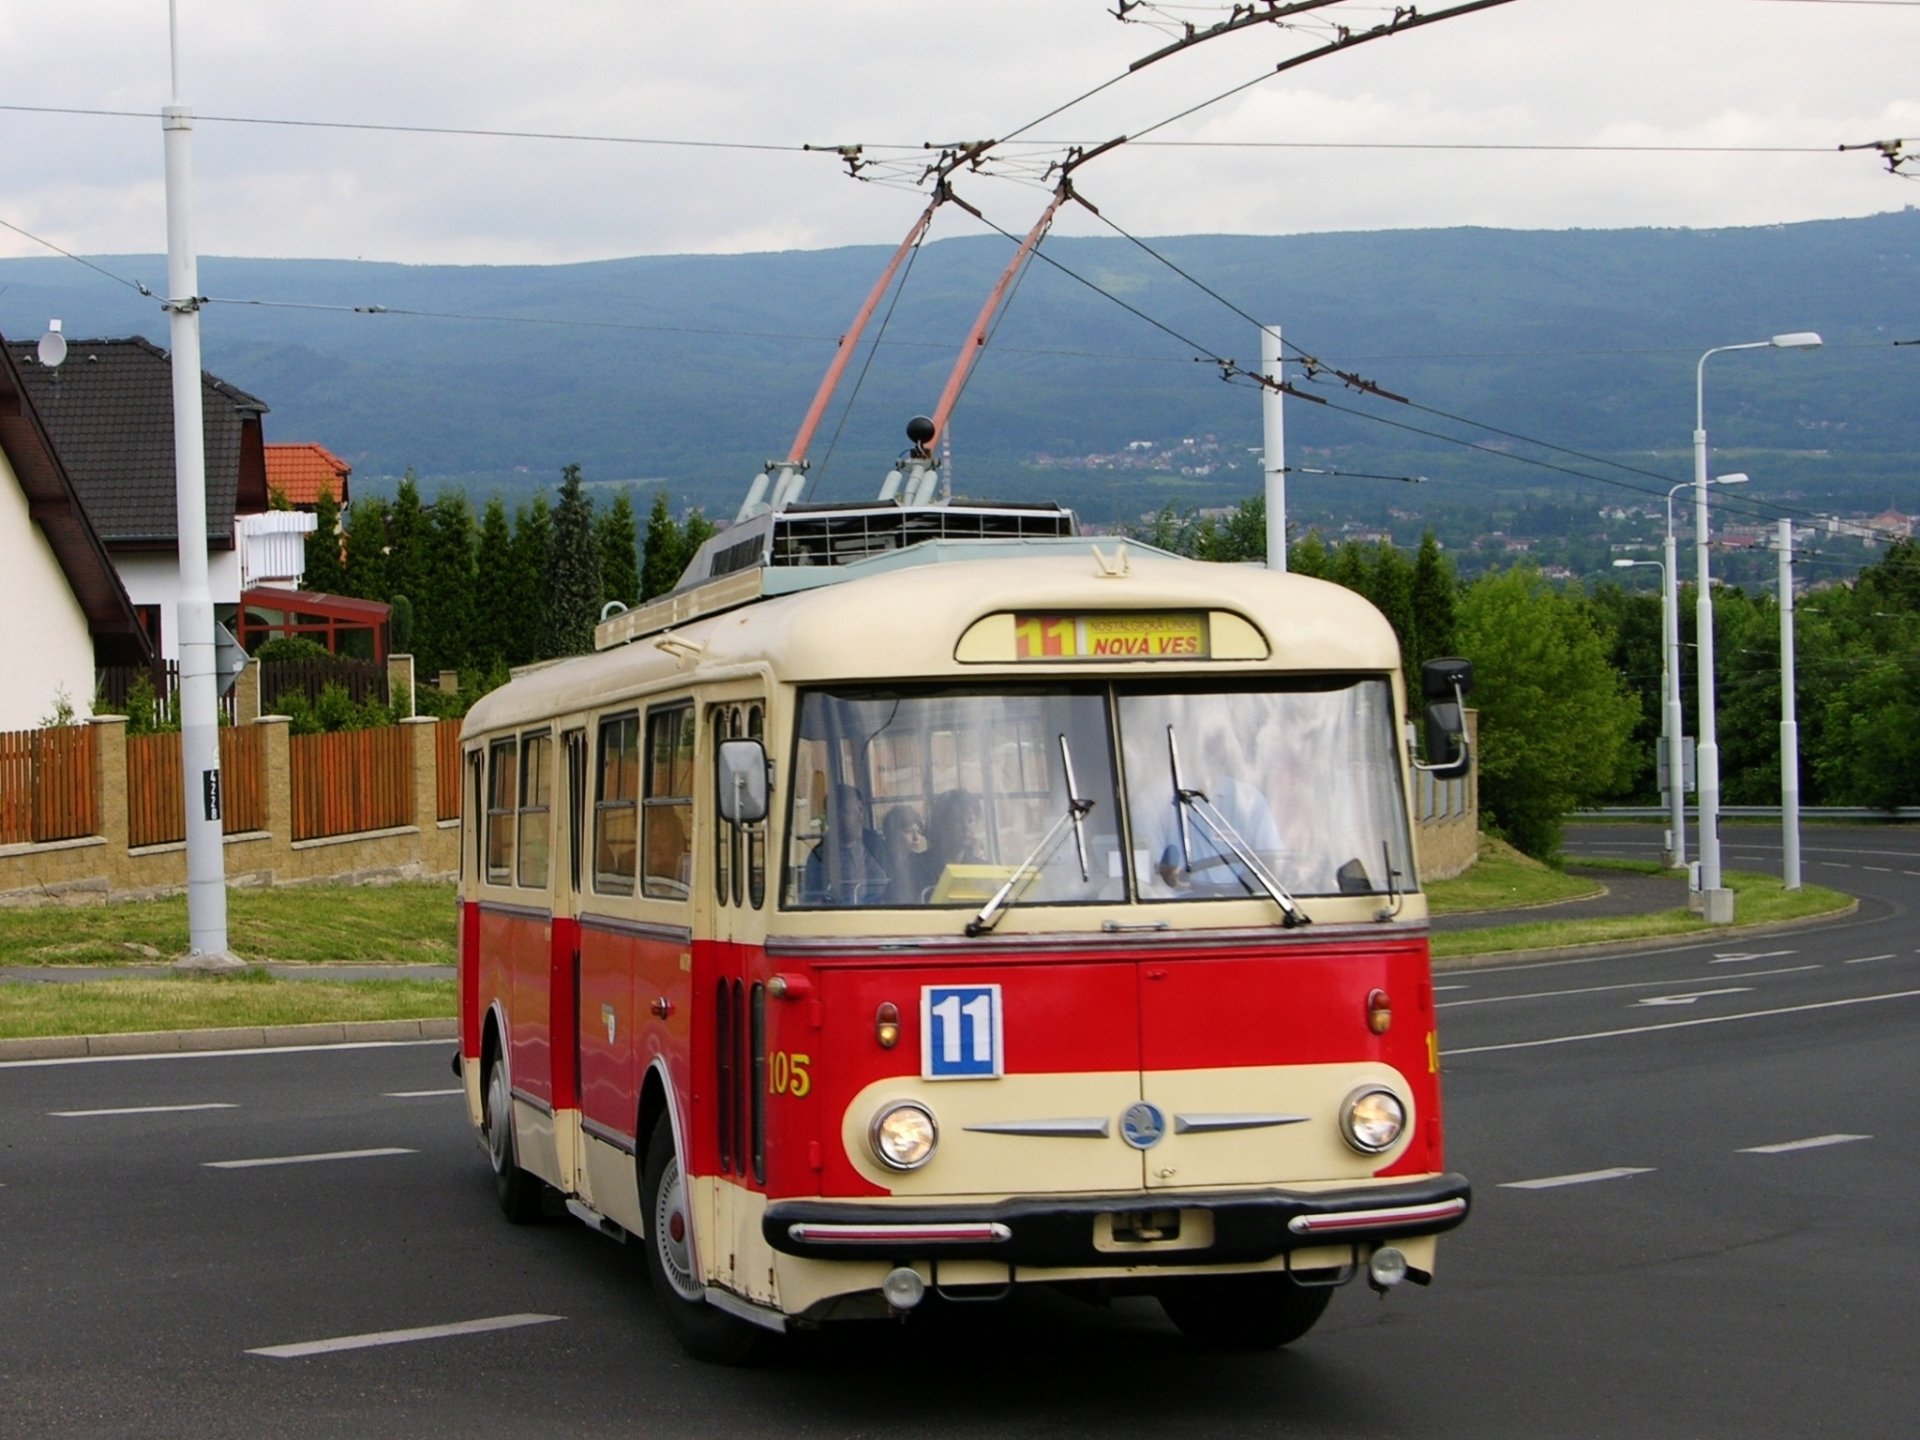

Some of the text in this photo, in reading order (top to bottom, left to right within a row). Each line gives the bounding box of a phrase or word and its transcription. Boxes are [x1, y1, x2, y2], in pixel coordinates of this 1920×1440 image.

[1015, 617, 1076, 656] 11
[1094, 632, 1198, 655] NOVÁ VES
[931, 994, 992, 1063] 11
[769, 1051, 810, 1097] 105
